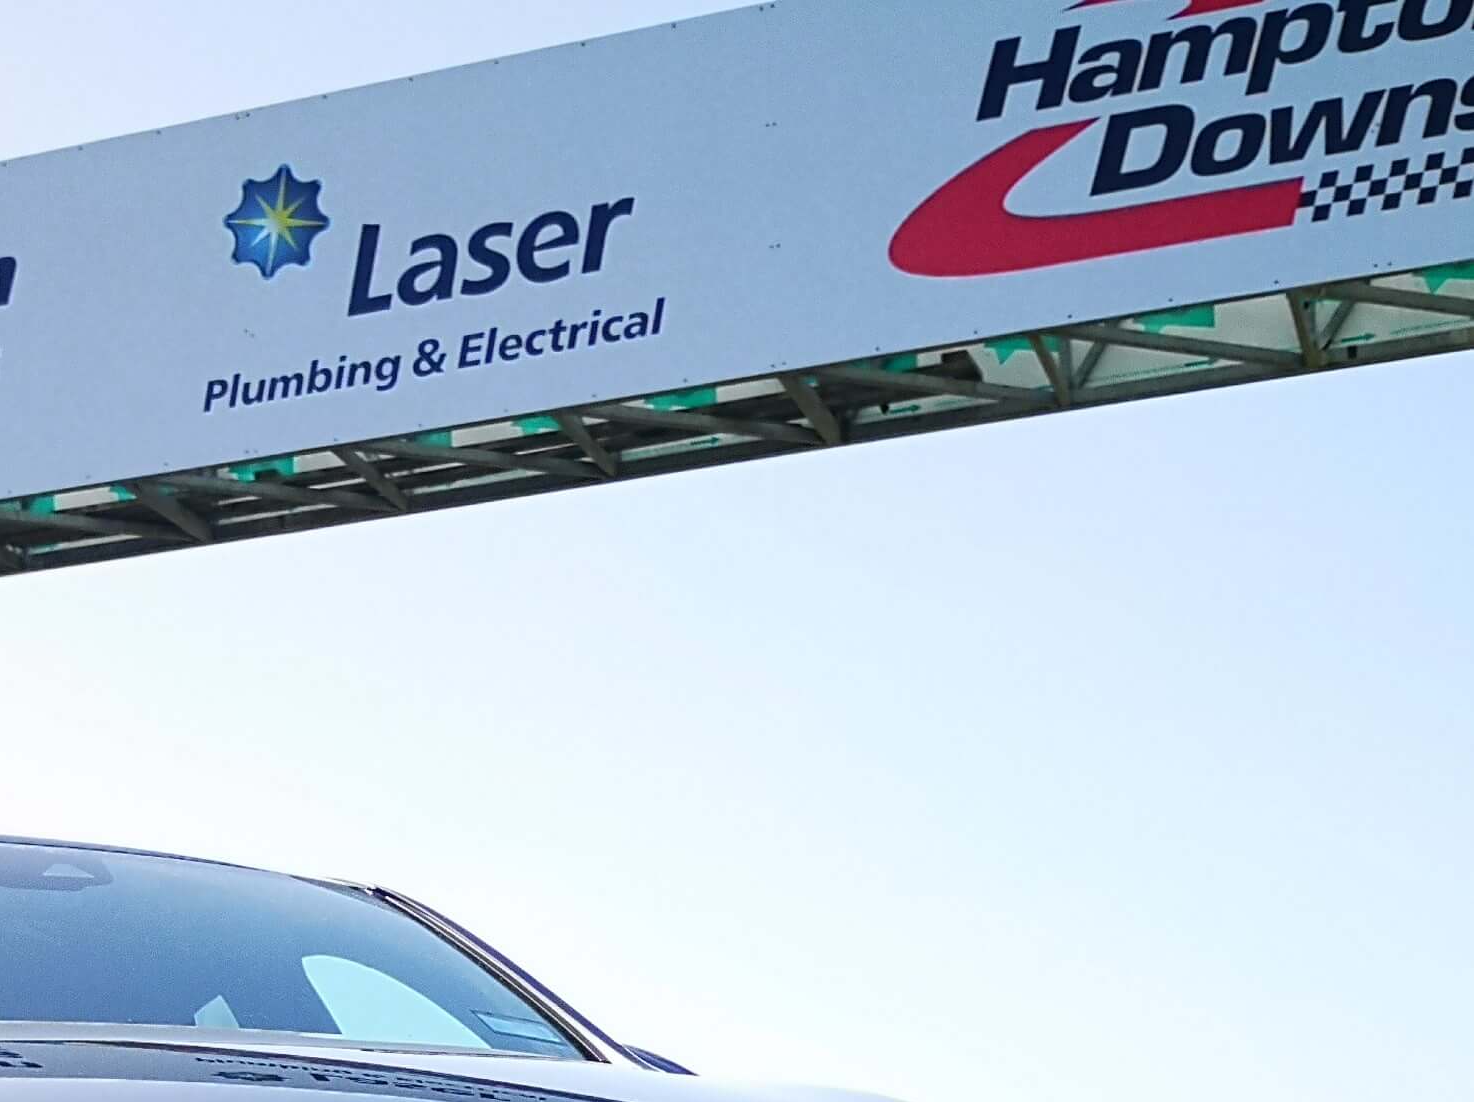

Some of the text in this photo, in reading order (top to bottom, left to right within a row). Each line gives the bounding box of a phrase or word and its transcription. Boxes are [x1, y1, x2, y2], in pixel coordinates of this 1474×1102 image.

[976, 0, 1474, 121] Hampto
[1090, 76, 1474, 196] Down
[347, 197, 635, 317] Laser
[203, 297, 666, 412] Plumbing & Electrical
